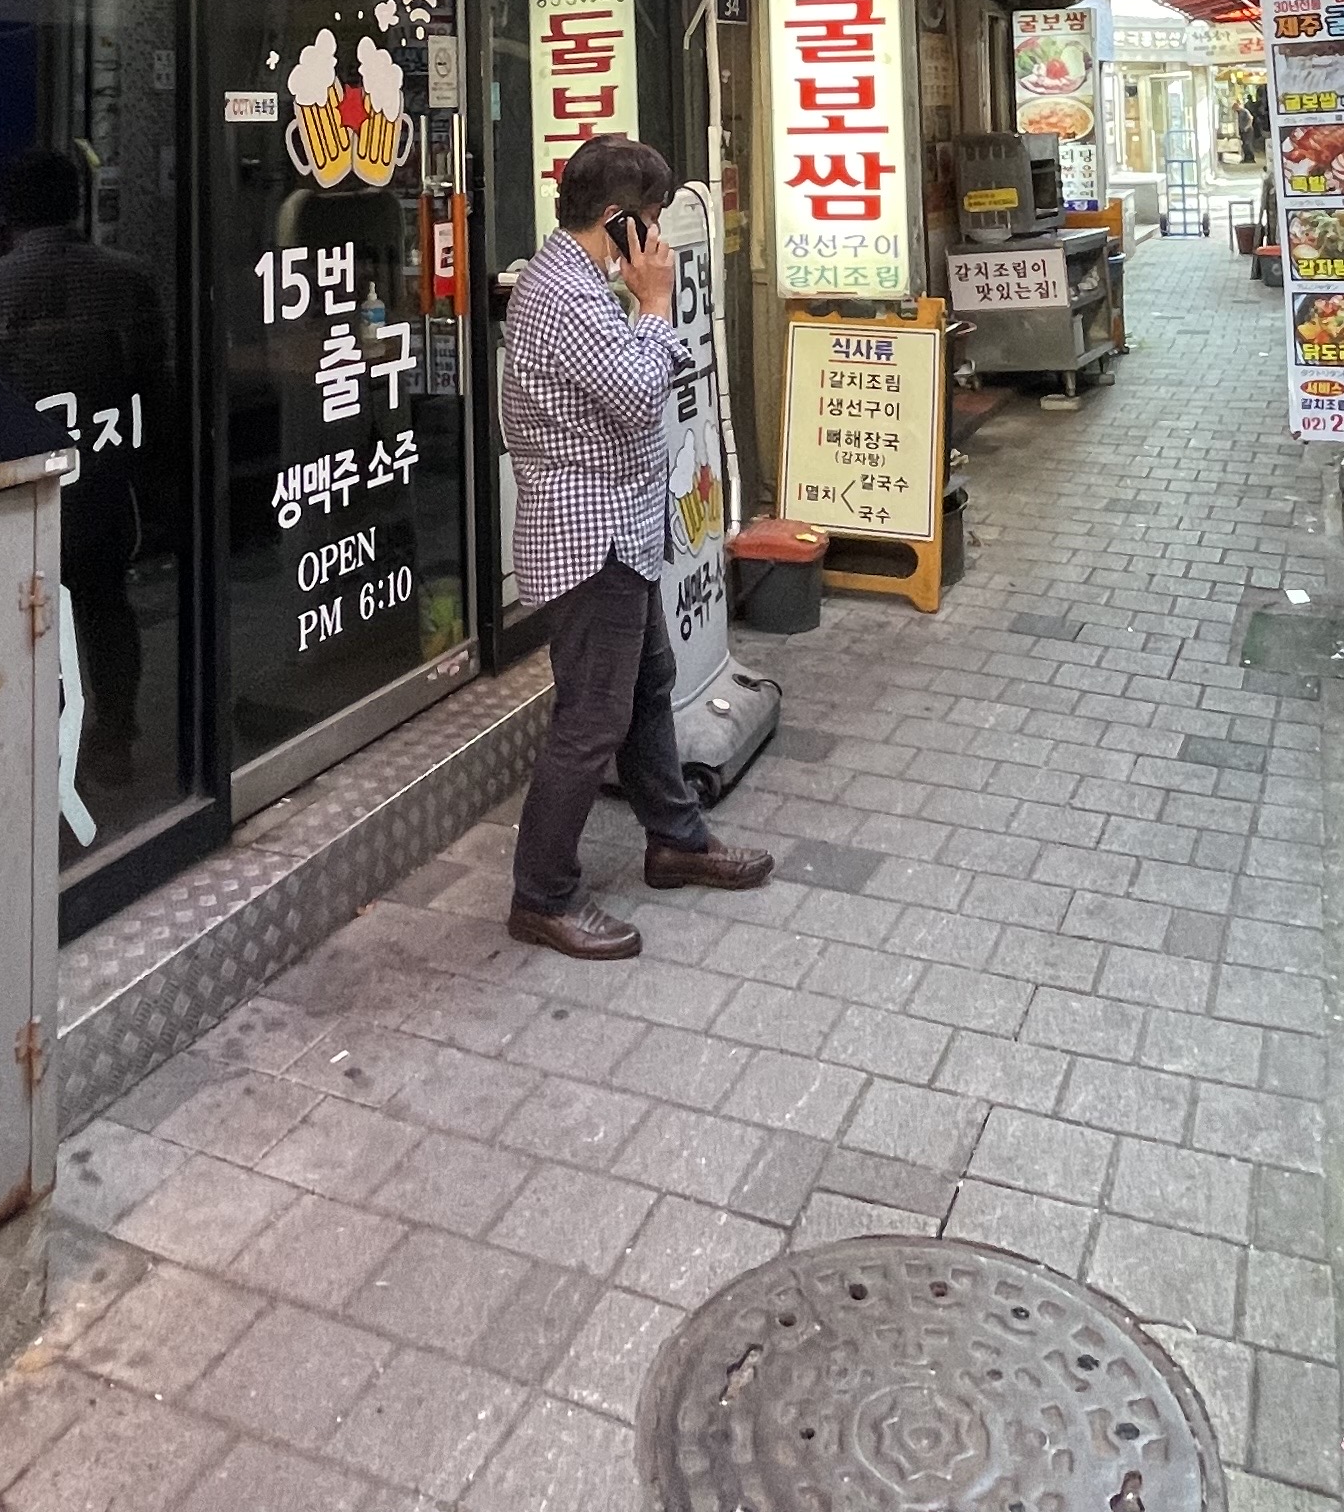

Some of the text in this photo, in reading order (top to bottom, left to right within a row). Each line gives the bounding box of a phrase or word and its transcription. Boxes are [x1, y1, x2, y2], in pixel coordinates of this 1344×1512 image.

[1017, 11, 1088, 34] 굴보쌈
[1274, 13, 1324, 38] 제주
[784, 234, 900, 259] 생선구이
[255, 242, 356, 324] 15번
[785, 264, 900, 290] 갈치조림
[955, 259, 1047, 283] 갈치조림이
[831, 337, 895, 361] 식사류
[315, 322, 418, 422] 출구
[828, 370, 901, 393] 갈치조림
[827, 397, 901, 422] 생선구이
[826, 427, 901, 452] 뼈해장국
[271, 429, 420, 529] 생맥주 소주
[858, 504, 892, 525] 국수
[297, 527, 377, 593] OPEN
[297, 565, 413, 652] PM 6:10
